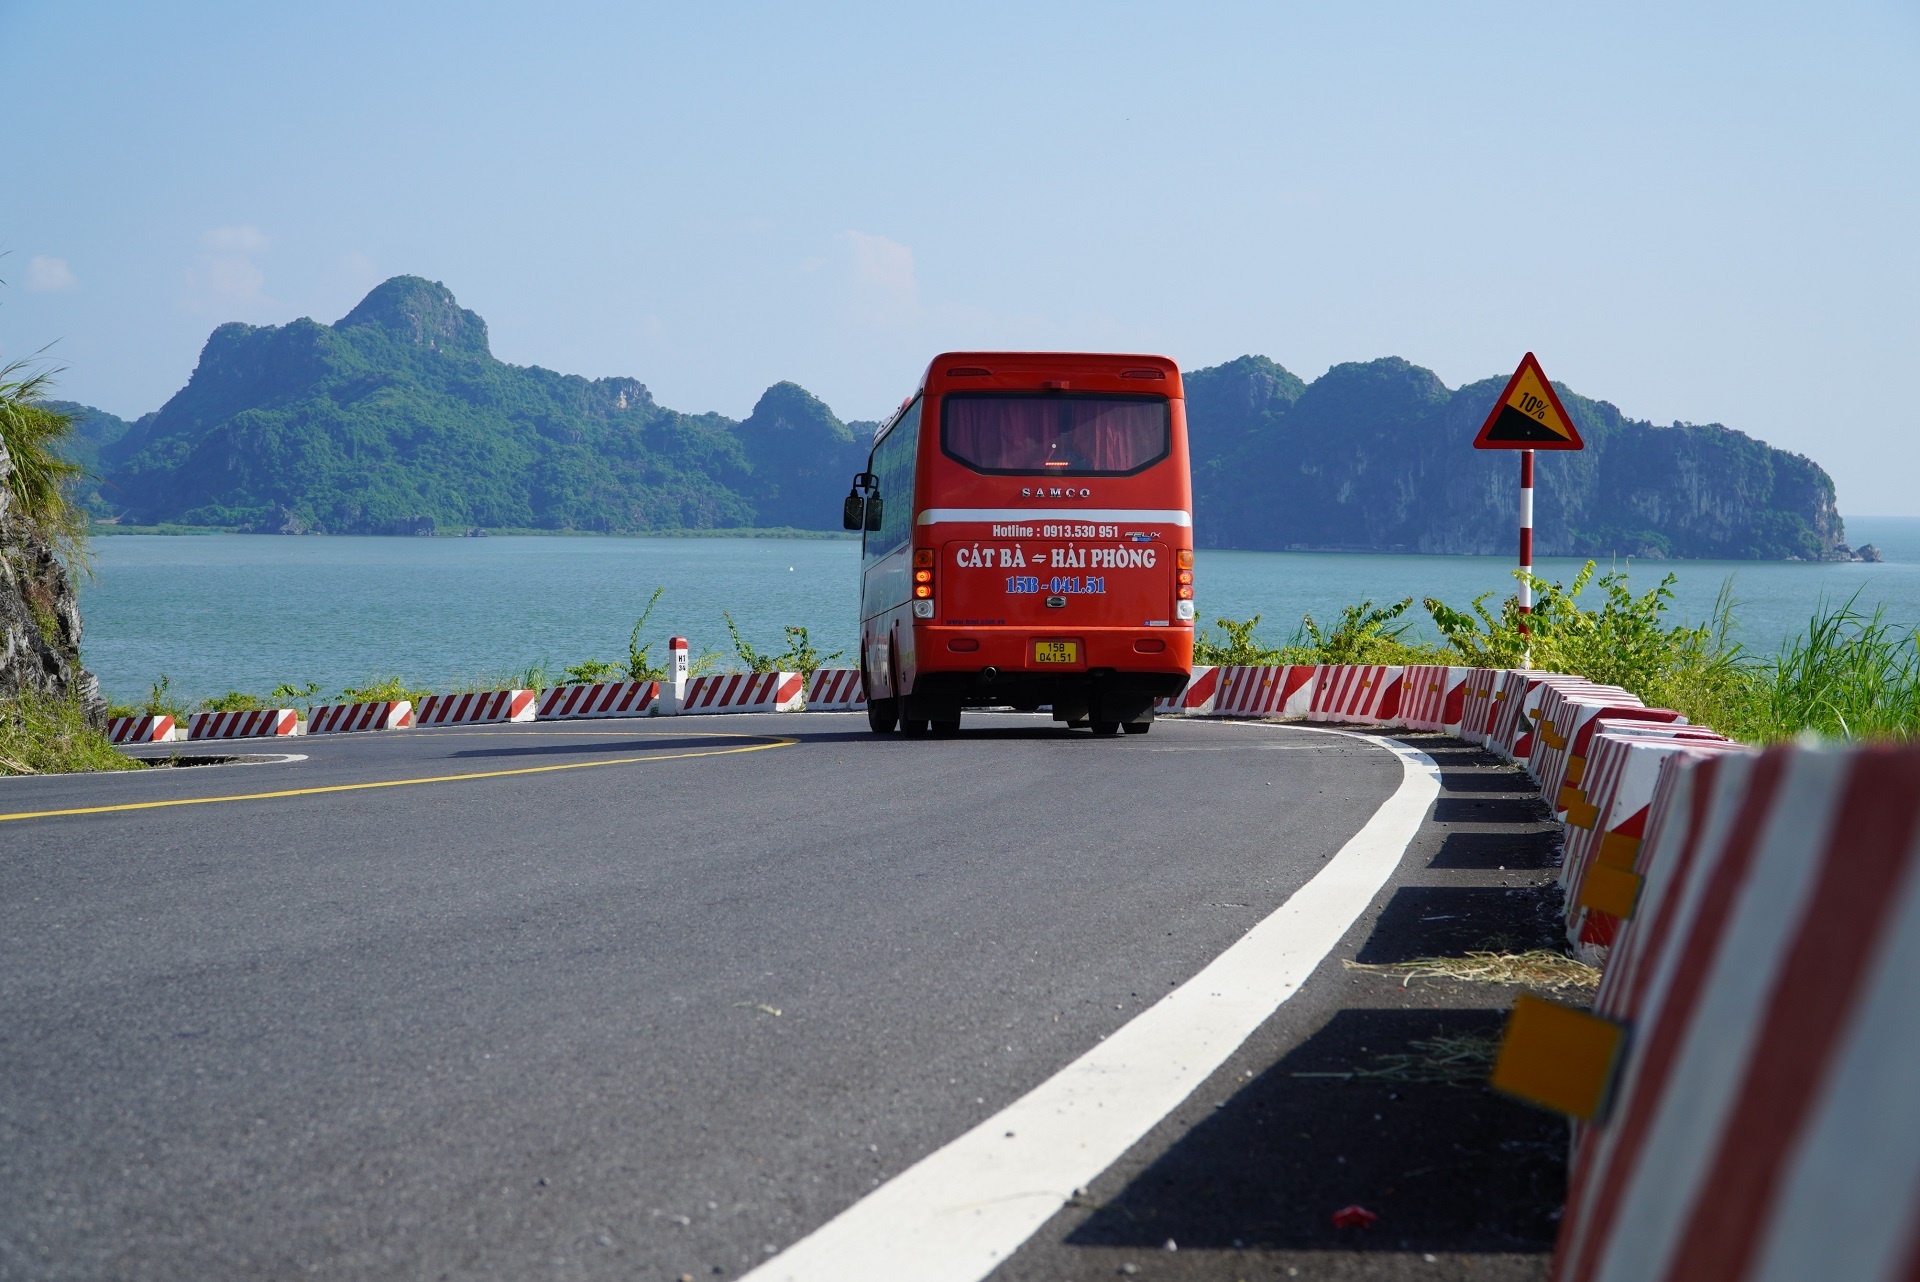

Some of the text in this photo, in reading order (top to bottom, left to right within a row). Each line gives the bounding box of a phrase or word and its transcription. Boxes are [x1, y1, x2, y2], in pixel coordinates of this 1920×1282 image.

[1519, 392, 1549, 420] 10%
[1021, 487, 1091, 498] SAMCO
[993, 524, 1034, 538] Hotline
[1043, 525, 1096, 538] 0913.530
[1099, 525, 1119, 538] 951
[1124, 531, 1162, 539] FELIX
[956, 542, 1157, 569] CÁT BÀ HẢI PHÒNG
[1048, 642, 1065, 653] 15B
[1039, 653, 1071, 663] 041.51
